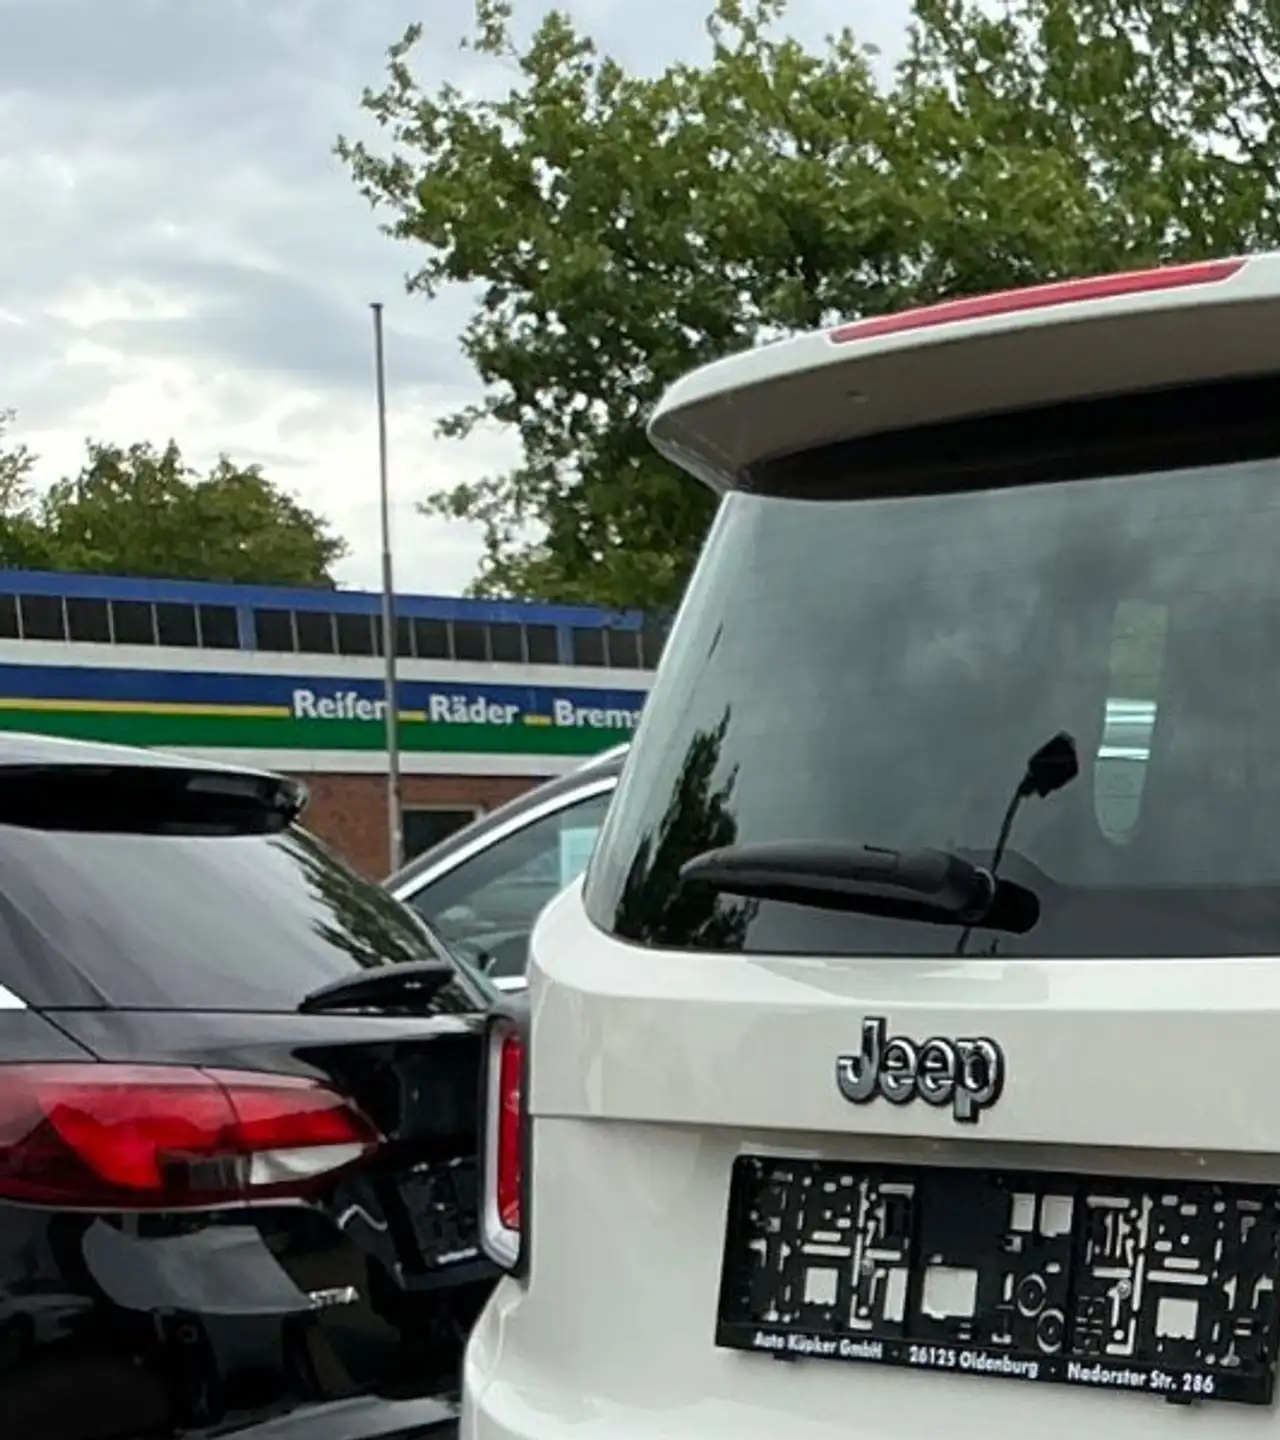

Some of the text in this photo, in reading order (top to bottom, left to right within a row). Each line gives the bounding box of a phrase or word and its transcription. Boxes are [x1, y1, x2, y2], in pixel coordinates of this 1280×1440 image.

[429, 693, 520, 724] Räder
[836, 1015, 1005, 1124] Jeep
[753, 1331, 785, 1349] Auto
[839, 1338, 883, 1359] GmbH
[908, 1345, 956, 1367] 26125
[959, 1352, 1039, 1379] Oldenburg
[1149, 1368, 1178, 1391] Str.
[1182, 1372, 1215, 1394] 286
